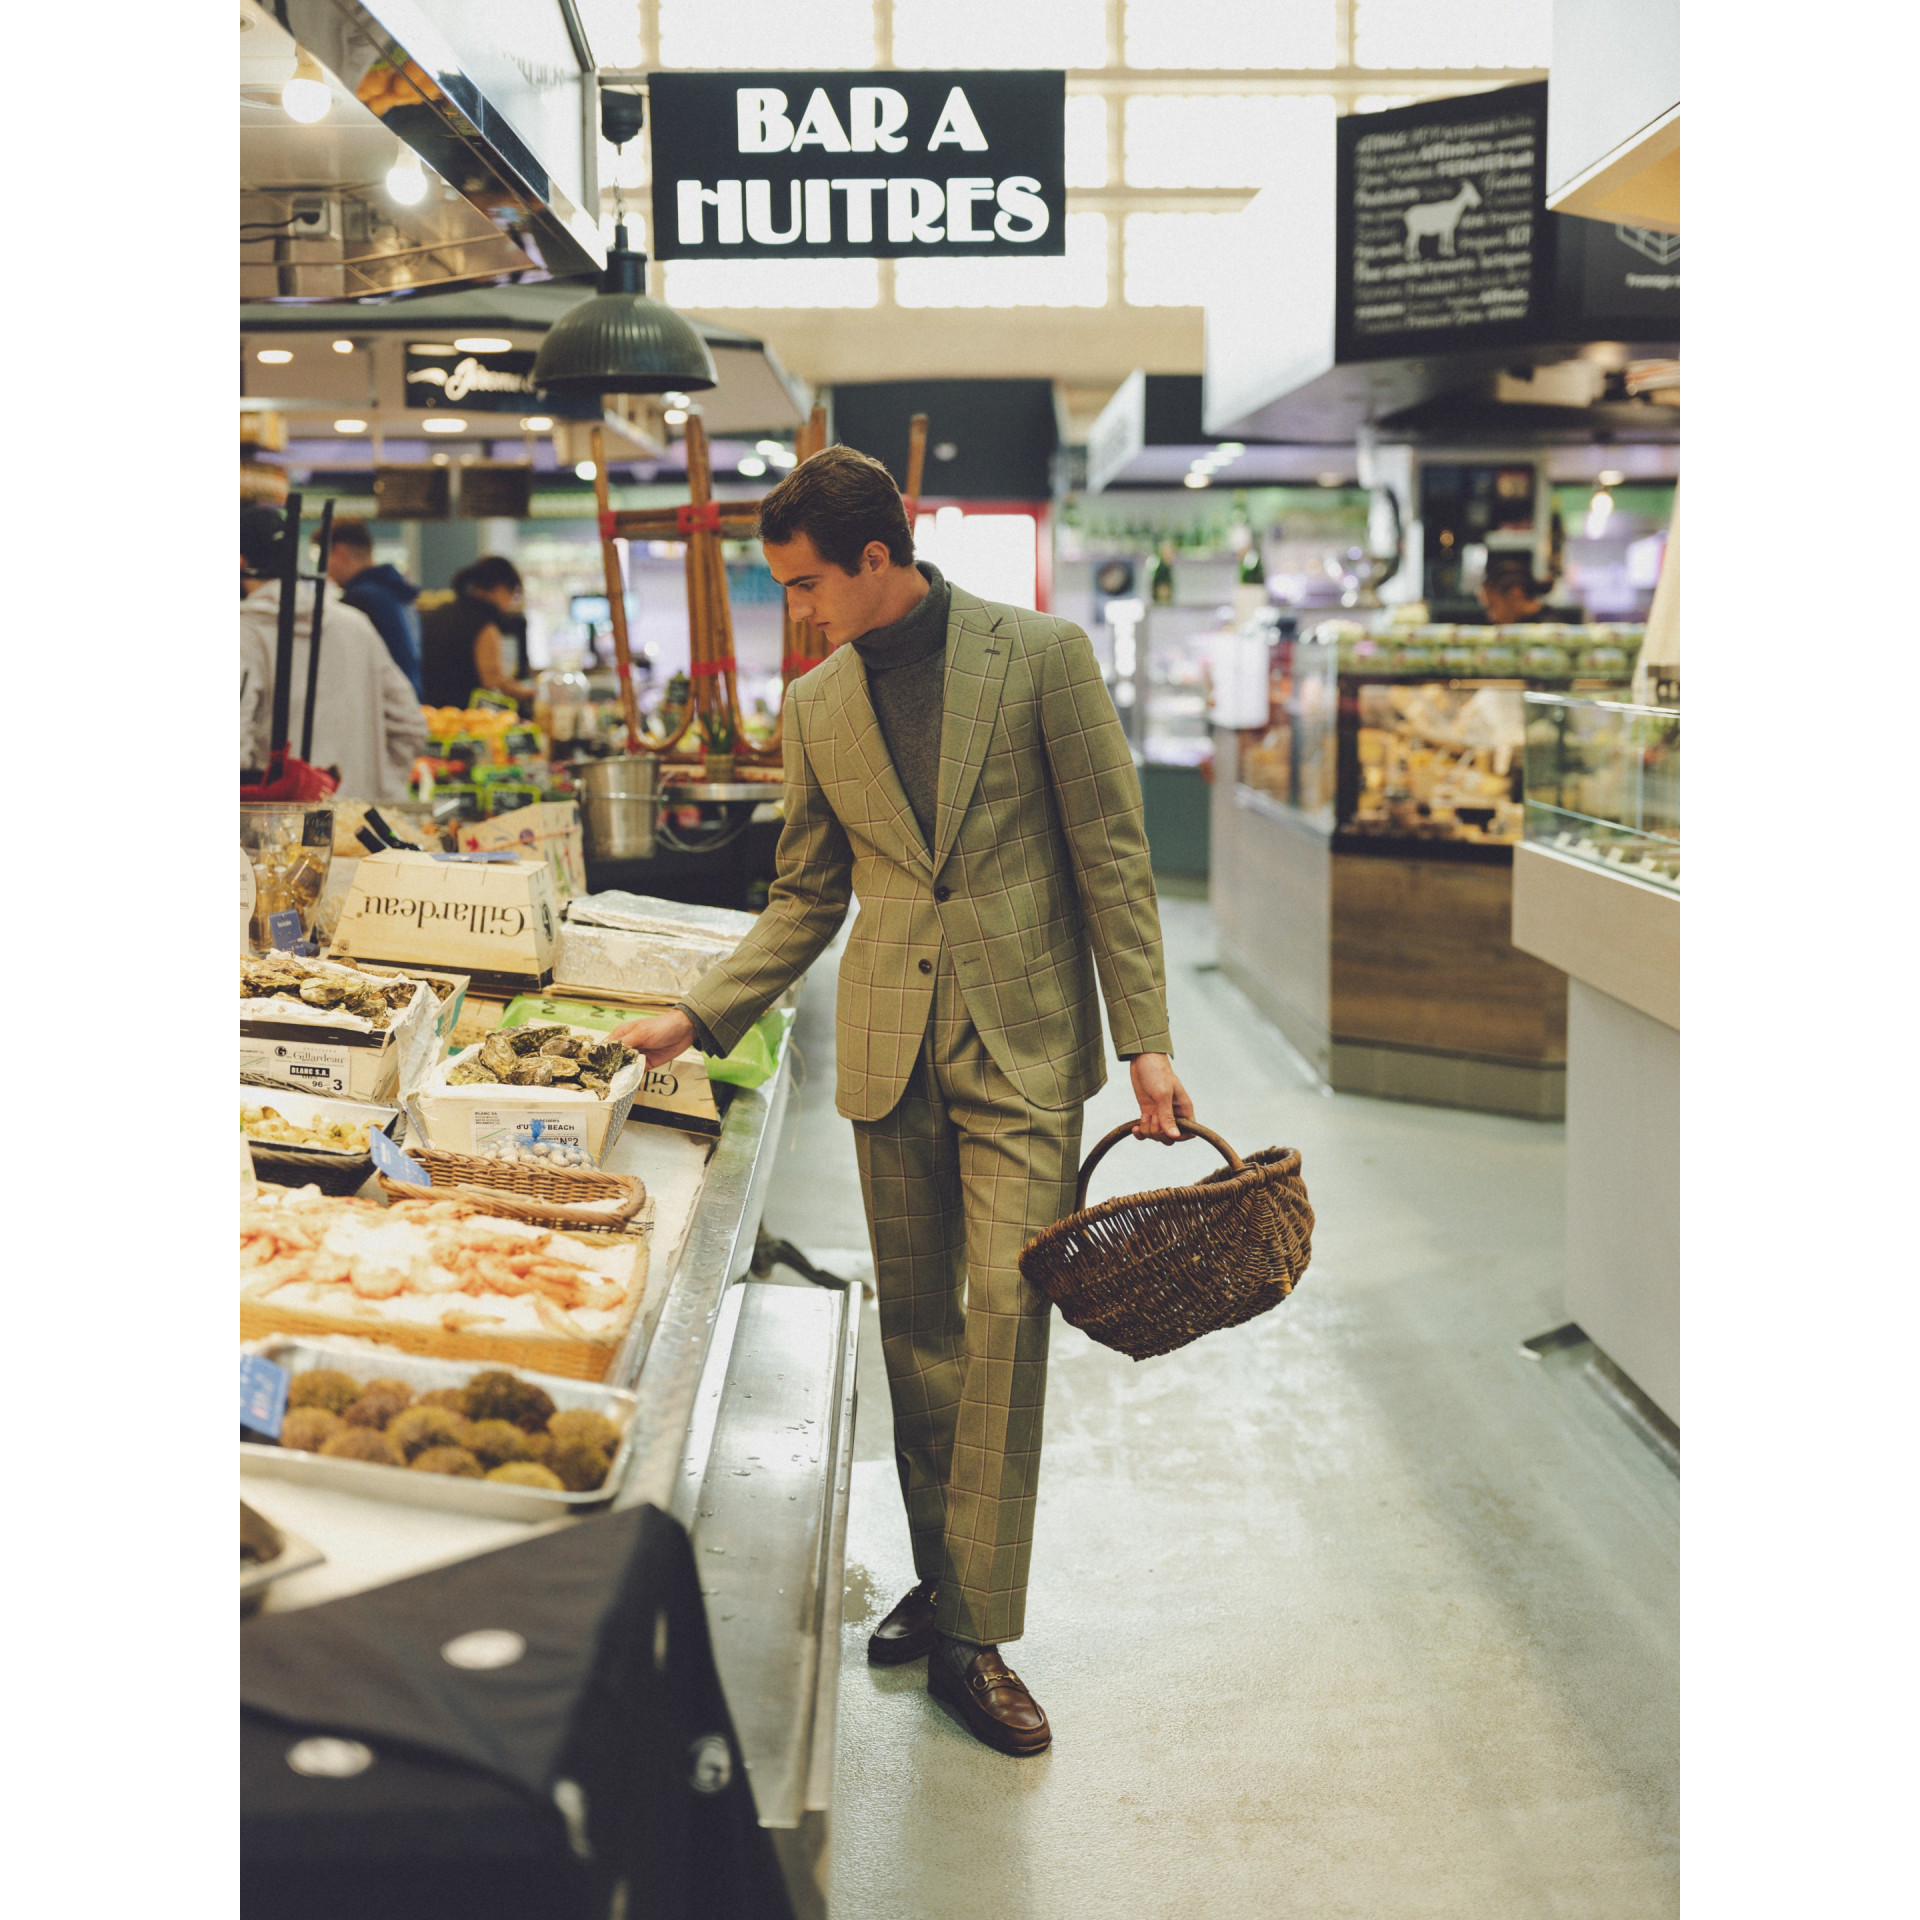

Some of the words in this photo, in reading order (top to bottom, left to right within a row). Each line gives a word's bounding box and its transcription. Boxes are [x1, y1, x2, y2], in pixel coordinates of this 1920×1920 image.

[736, 86, 908, 154] BAR
[927, 86, 988, 152] A
[676, 175, 1050, 245] HUITRES
[363, 896, 526, 938] Gillardeau
[293, 1051, 345, 1064] Gillardeau
[291, 1066, 314, 1075] BLANC
[315, 1068, 329, 1077] S.A.
[637, 1071, 679, 1097] Gil
[333, 1079, 343, 1091] 3
